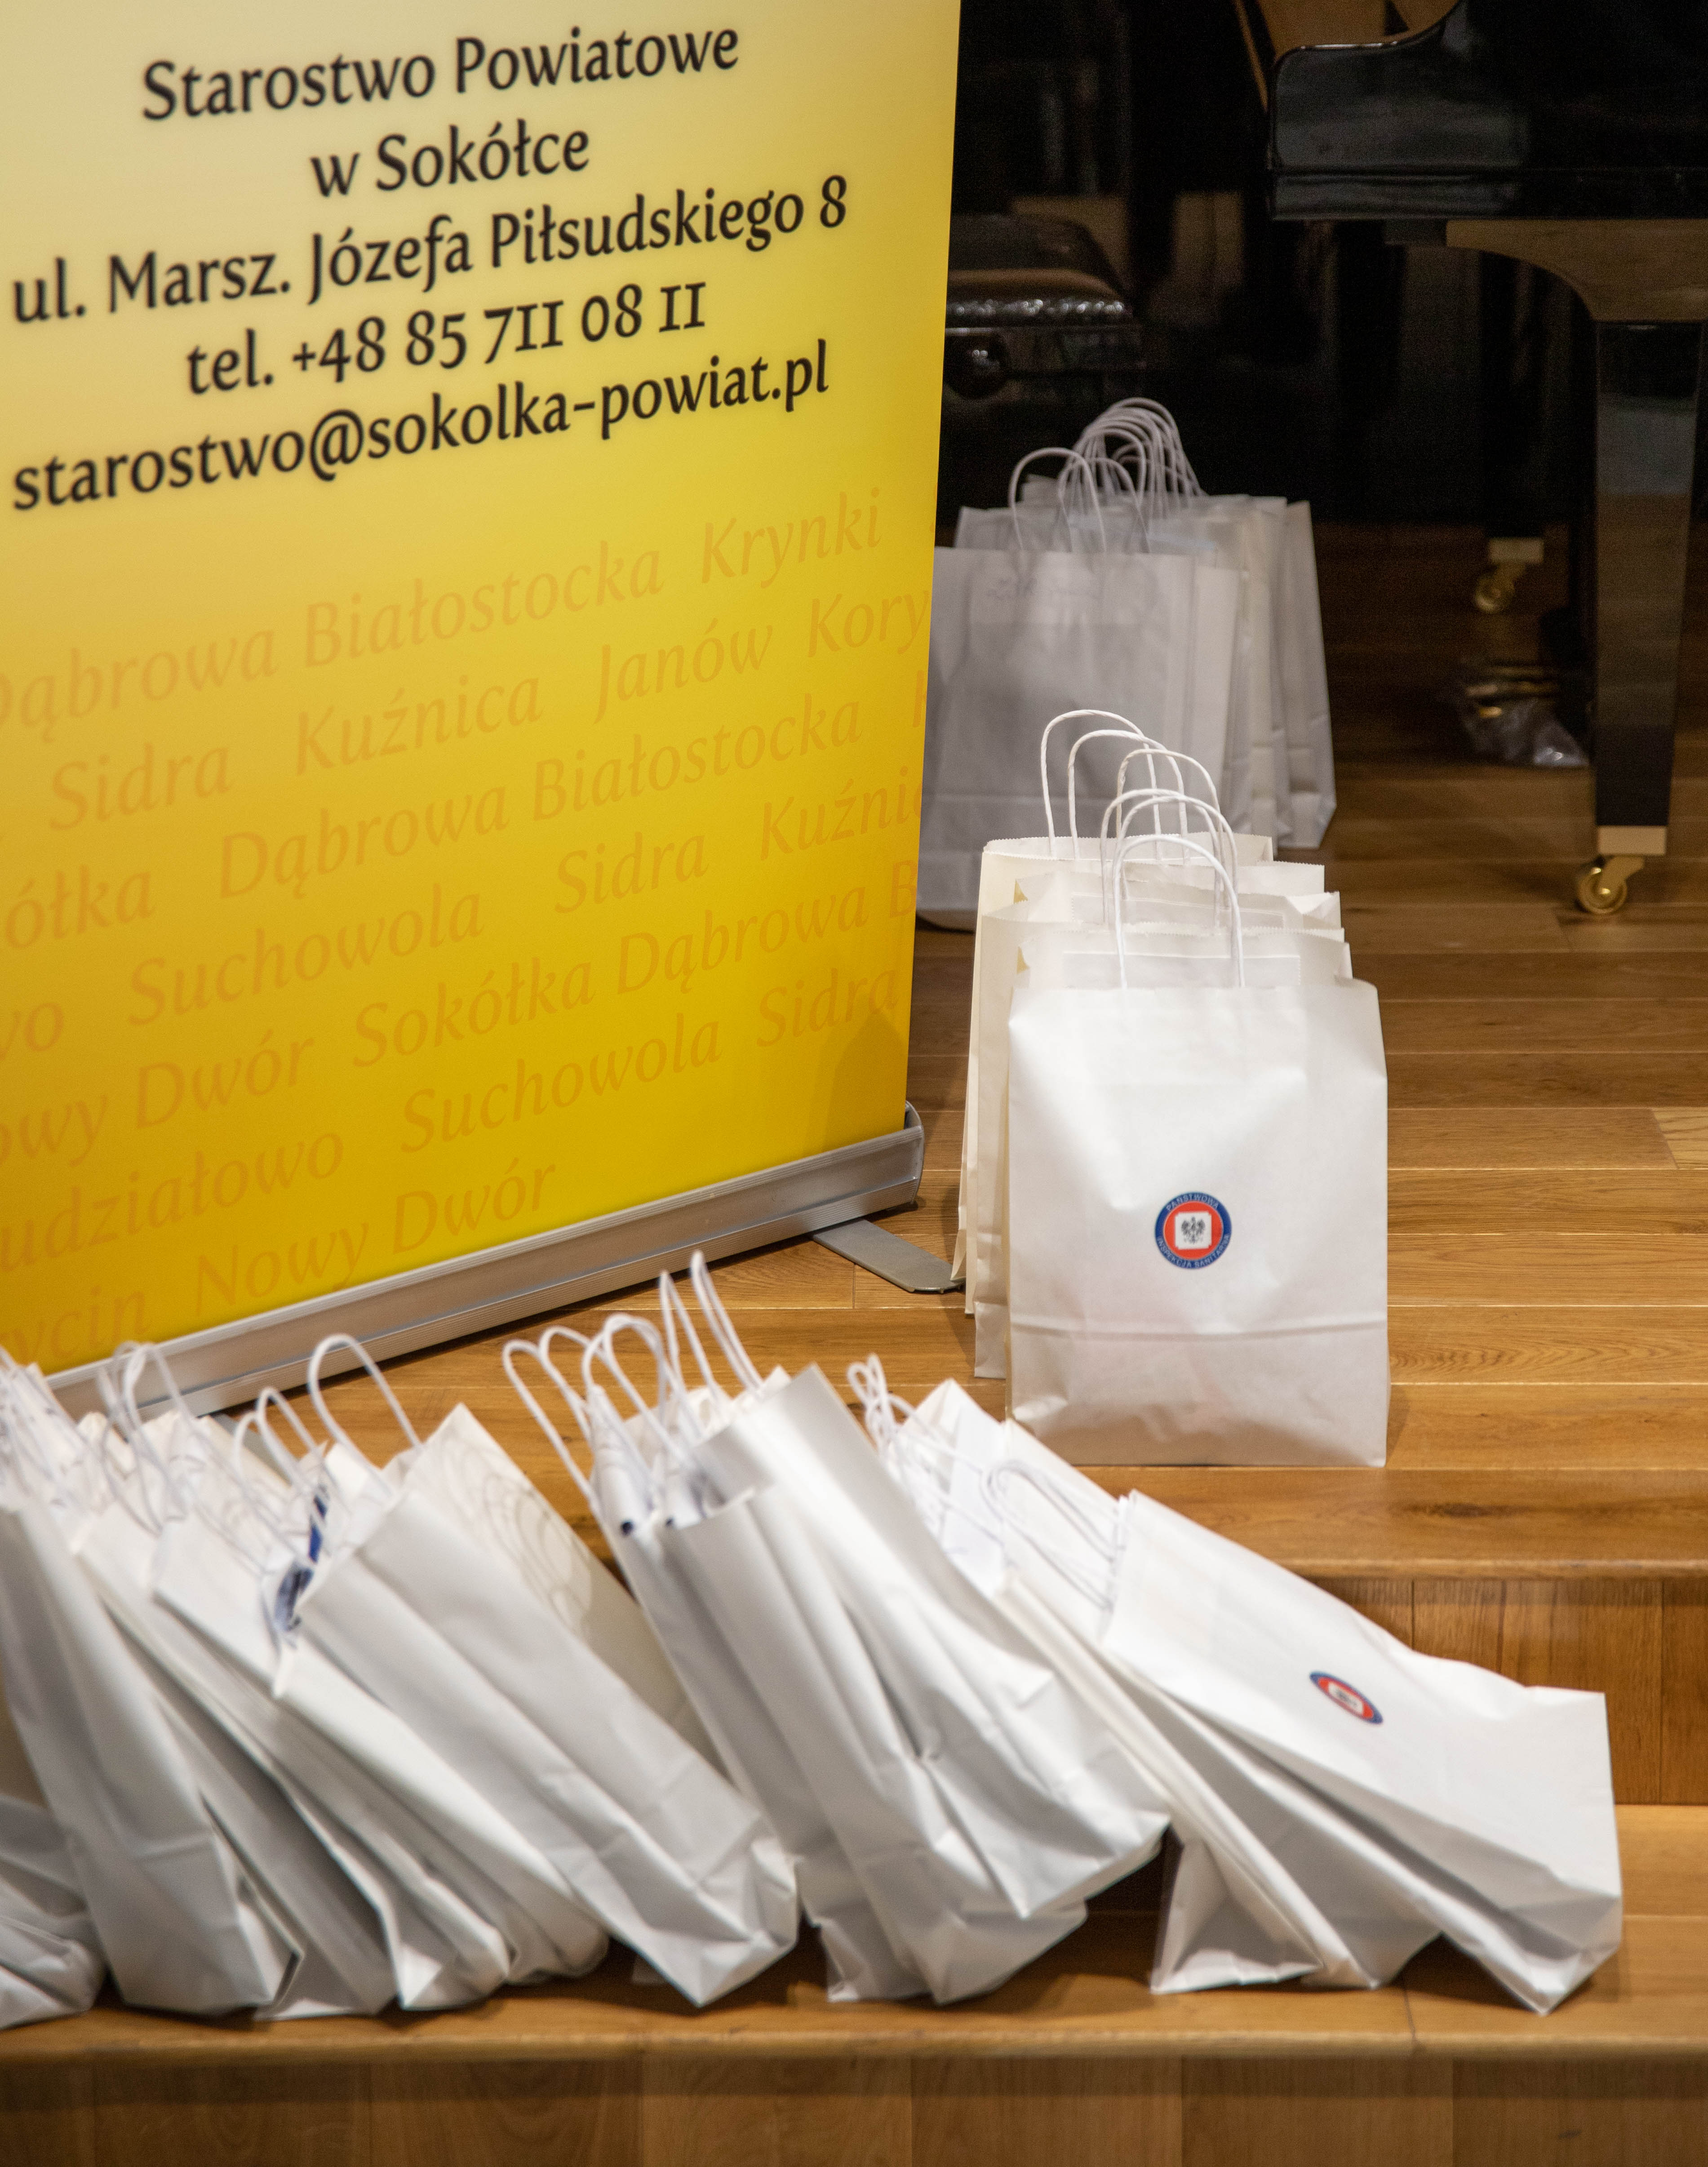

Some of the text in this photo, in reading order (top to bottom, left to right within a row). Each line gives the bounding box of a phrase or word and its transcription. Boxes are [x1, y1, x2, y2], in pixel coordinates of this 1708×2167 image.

[143, 26, 738, 121] Starostwo Powiatowe
[311, 118, 589, 197] w Sokółce
[13, 174, 847, 324] ul. Marsz. Józefa Piłsudskiego 8
[14, 338, 829, 511] starostwo@sokolka-powiat.pl
[187, 328, 273, 395] tel.
[293, 316, 386, 383] +48
[406, 310, 467, 370] 85
[484, 300, 564, 364] 711
[581, 283, 643, 342] 08
[305, 541, 664, 668] Białostocka
[701, 487, 881, 588] Krynki
[49, 590, 929, 830] Sidra Kuźnica Janów Kory
[5, 864, 156, 949] ółka
[221, 785, 510, 898] Dąbrowa
[533, 693, 863, 822] Białostocka
[128, 882, 484, 1026] Suchowola
[555, 832, 709, 914] Sidra
[136, 1029, 315, 1129] Dwór
[354, 957, 597, 1068] Sokółka
[617, 887, 869, 994] Dąbrowa
[401, 1013, 723, 1153] Suchowola
[757, 968, 897, 1047] Sidra
[196, 1222, 369, 1316] Nowy
[393, 1157, 556, 1254] Dwór
